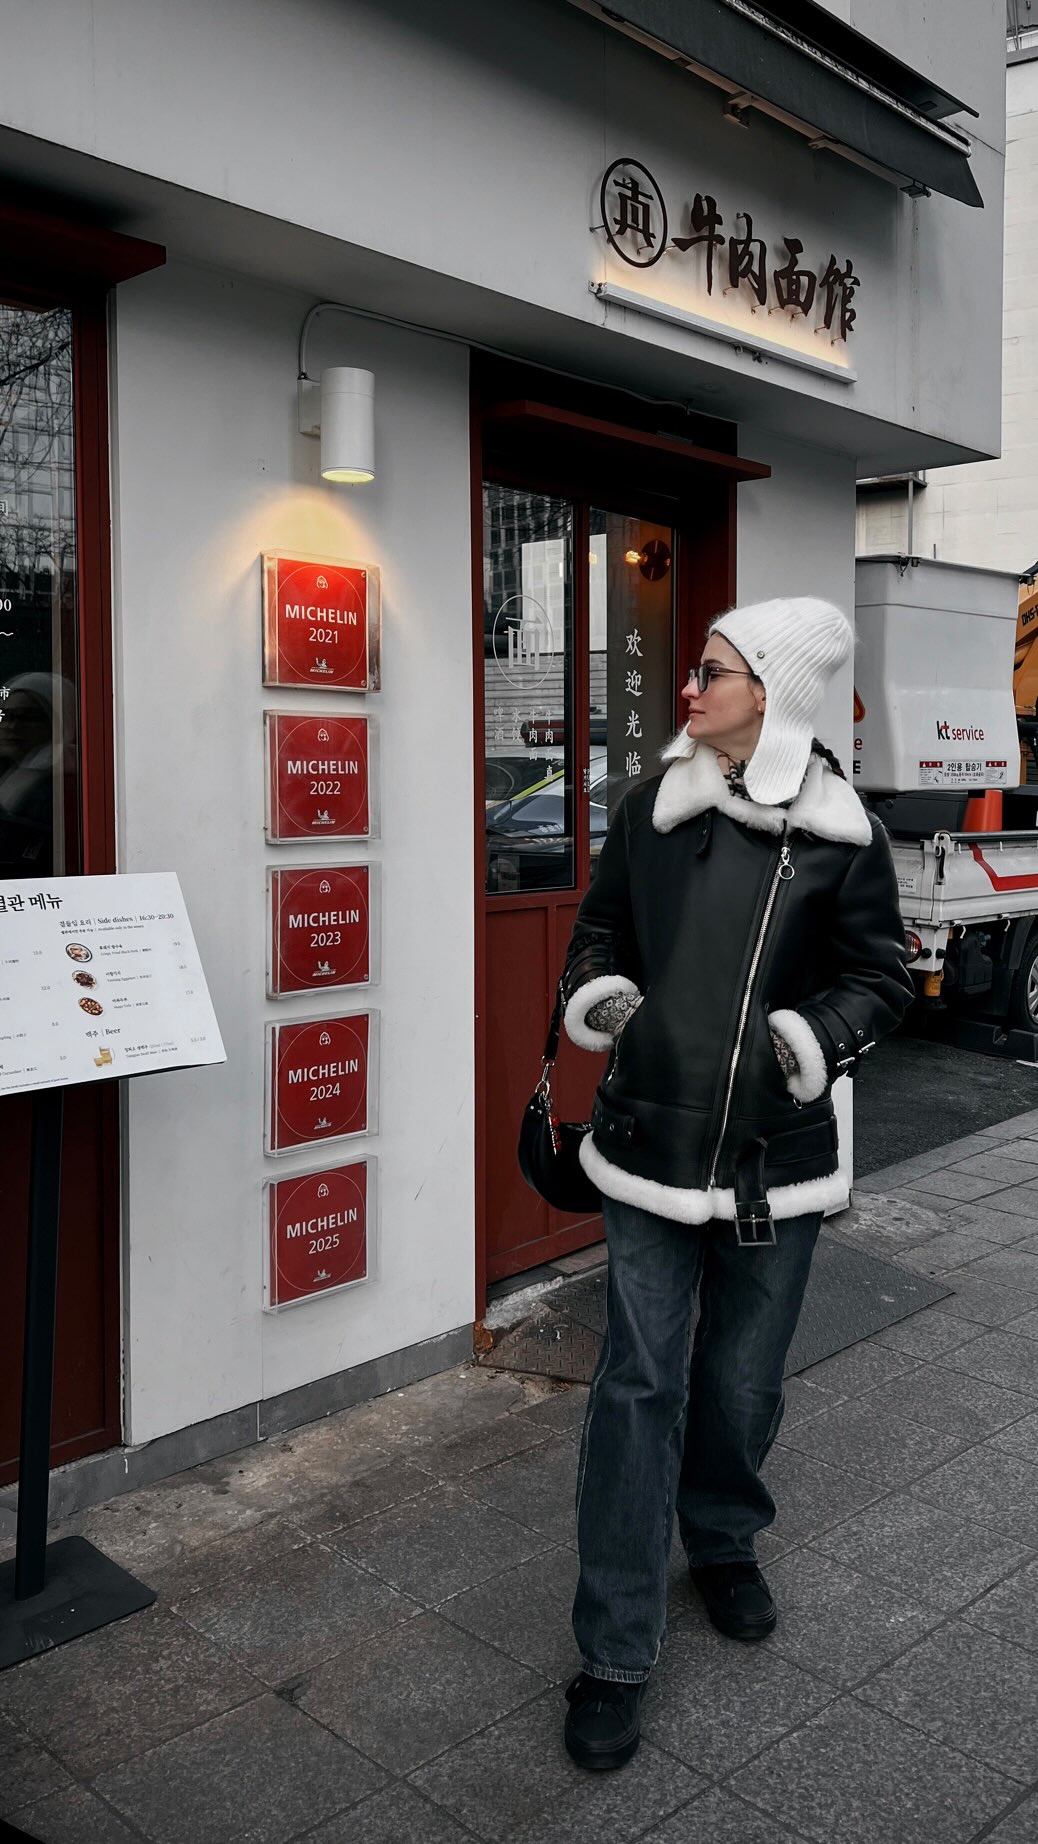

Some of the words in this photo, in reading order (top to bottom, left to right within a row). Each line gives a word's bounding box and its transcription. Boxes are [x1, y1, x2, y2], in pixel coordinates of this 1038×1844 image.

[285, 604, 357, 625] MICHELIN
[309, 628, 338, 644] 2021
[625, 629, 643, 778] 欢迎光临
[936, 720, 950, 740] kt
[952, 725, 985, 740] service
[287, 760, 358, 774] MICHELIN
[310, 781, 341, 795] 2022
[28, 893, 63, 910] 메뉴
[289, 909, 359, 928] MICHELIN
[310, 931, 341, 947] 2023
[288, 1058, 358, 1084] MICHELIN
[310, 1082, 341, 1101] 2024
[286, 1207, 357, 1239] MICHELIN
[308, 1233, 340, 1254] 2025
